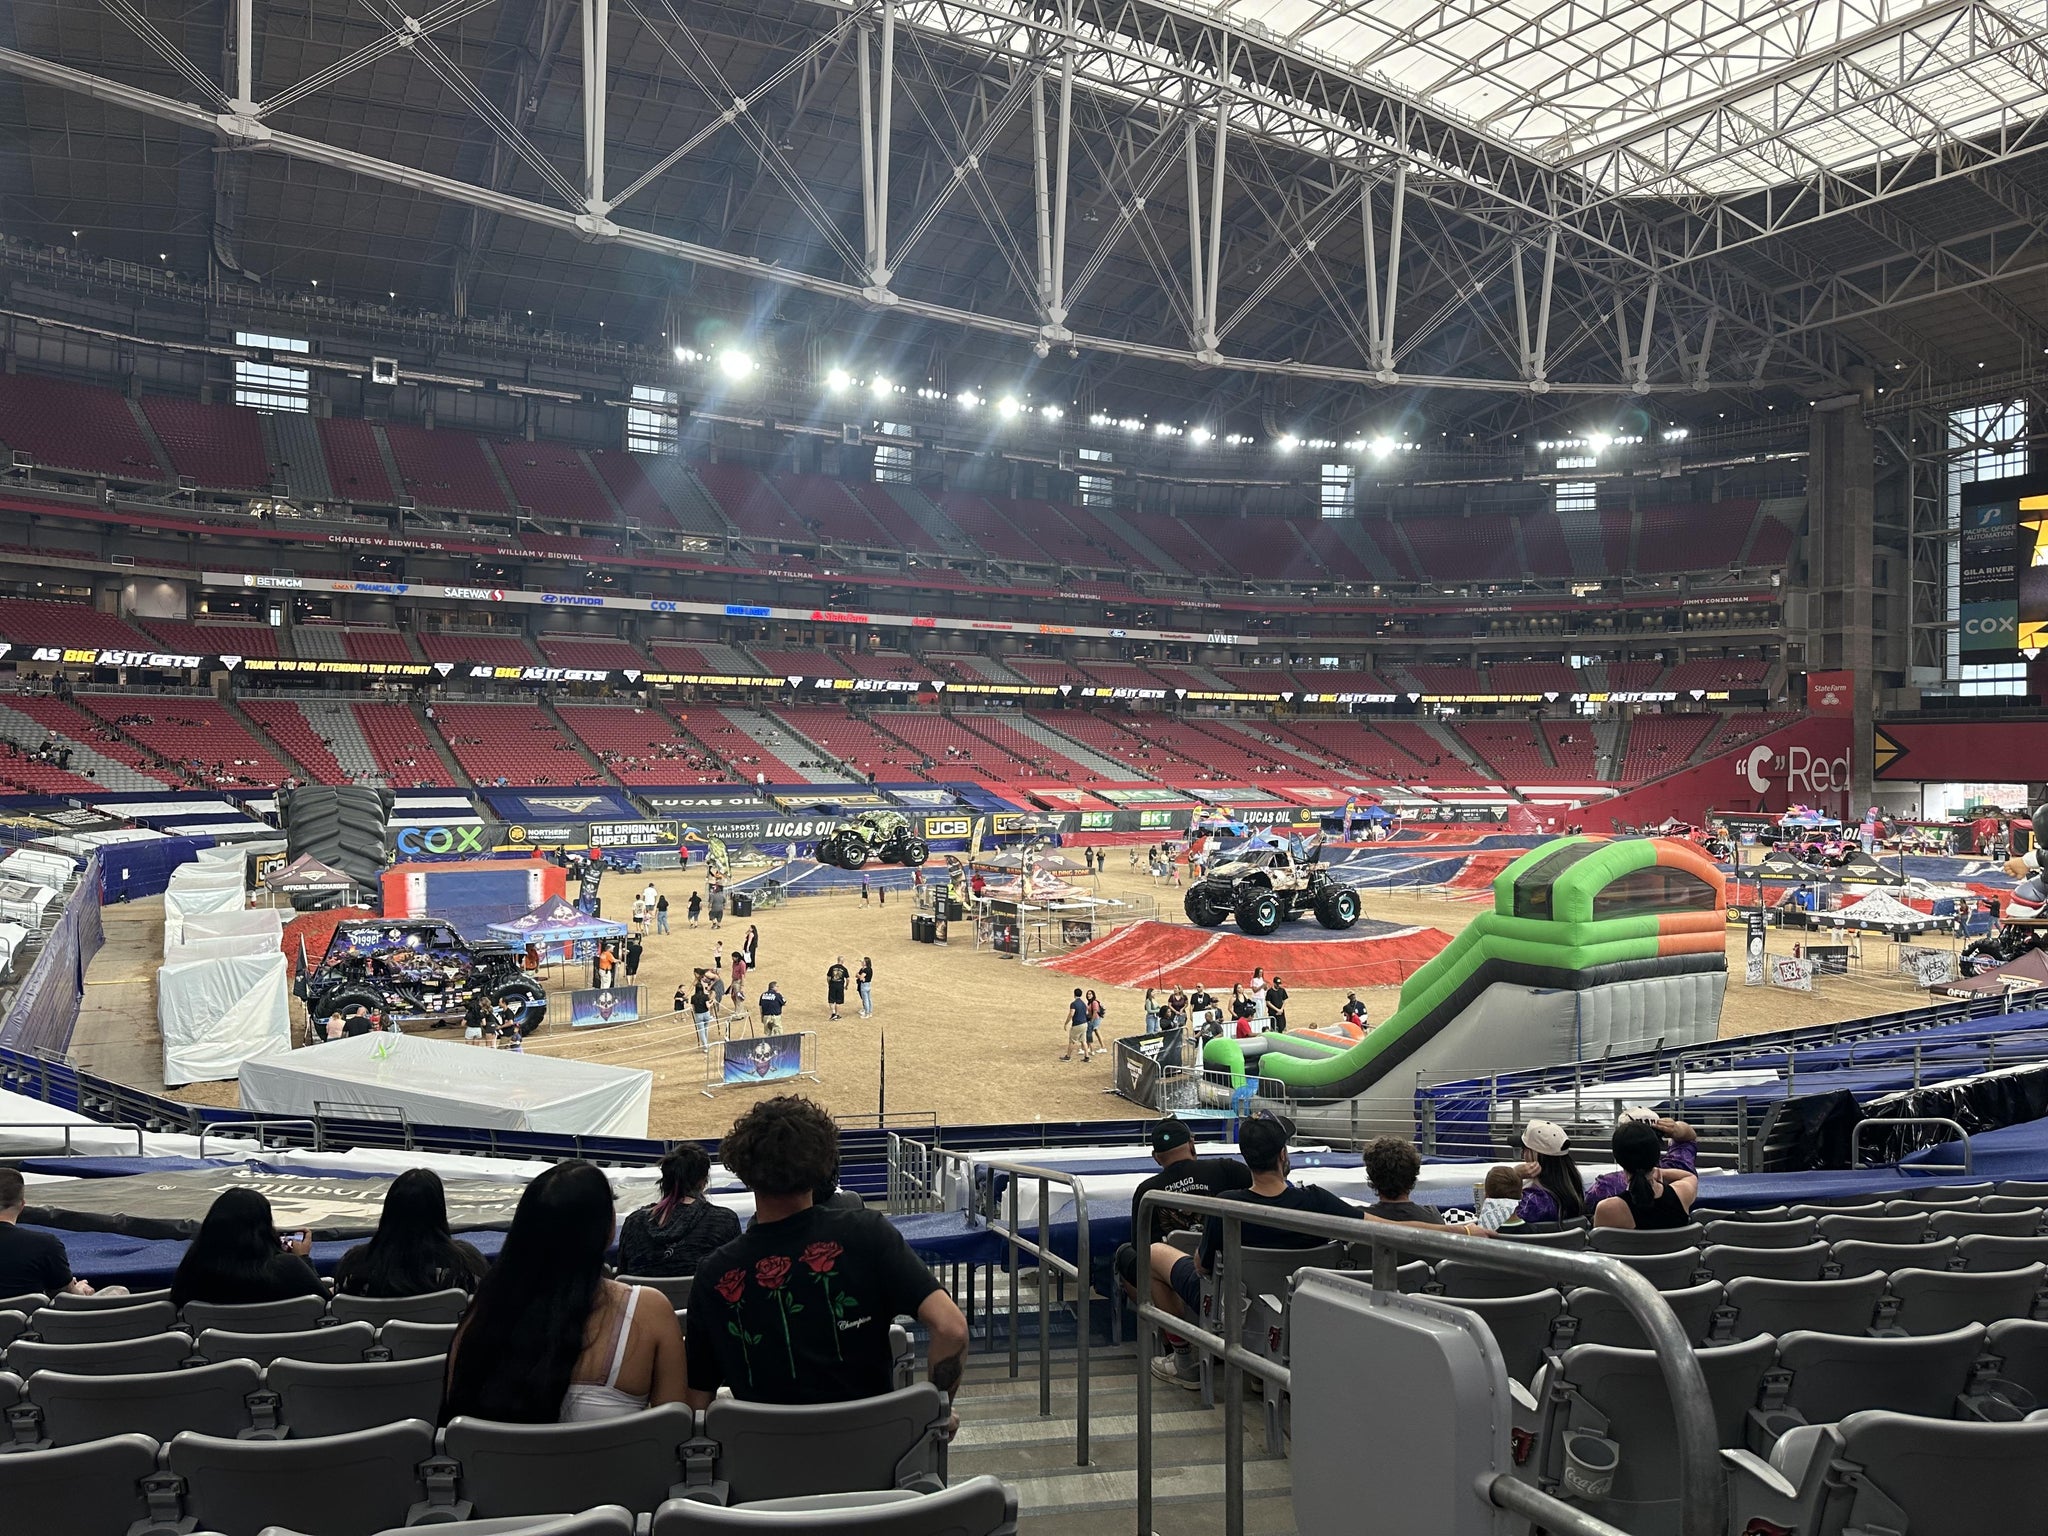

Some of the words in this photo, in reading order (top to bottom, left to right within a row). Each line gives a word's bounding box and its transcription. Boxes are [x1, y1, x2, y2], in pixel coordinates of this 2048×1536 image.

[1963, 527, 1989, 536] PACIFIC
[1991, 524, 2016, 532] OFFICE
[1966, 531, 2014, 541] AUTOMATION
[328, 535, 372, 545] CHARLES
[373, 538, 386, 546] W.
[388, 539, 428, 549] BIDWILL,
[497, 548, 536, 557] WILLIAM
[548, 552, 583, 561] BIDWILL
[783, 571, 813, 579] TILLMAN
[1963, 568, 1985, 576] GILA
[1986, 566, 2014, 574] RIVER
[257, 576, 303, 588] BETMGM
[444, 587, 491, 600] SAFEWAY
[559, 596, 604, 606] HYUNDAI
[650, 601, 676, 611] COX
[1705, 596, 1749, 604] CONZELMAN
[1965, 616, 2014, 634] COX
[1207, 634, 1239, 645] AVNET
[32, 648, 61, 661] AS
[63, 649, 97, 663] BIG
[98, 651, 125, 665] AS
[126, 652, 149, 667] IT
[244, 660, 276, 671] THANK
[278, 661, 297, 672] YOU
[297, 662, 317, 672] FOR
[317, 662, 368, 673] ATTENDING
[368, 664, 386, 674] THE
[387, 665, 402, 674] PIT
[402, 665, 432, 675] PARTY
[470, 666, 493, 678] AS
[494, 667, 522, 679] BIG
[522, 668, 545, 680] AS
[546, 668, 563, 681] IT
[815, 679, 833, 689] AS
[833, 679, 853, 690] BIG
[854, 680, 872, 691] AS
[1814, 684, 1847, 692] StateFarm
[1081, 688, 1095, 697] AS
[1096, 688, 1113, 697] BIG
[1113, 688, 1127, 698] AS
[1570, 693, 1587, 701] AS
[1588, 693, 1608, 701] BIG
[1609, 692, 1627, 702] AS
[1627, 692, 1642, 702] IT
[1788, 746, 1850, 793] Red
[1081, 813, 1113, 826] BKT
[1140, 812, 1171, 826] BKT
[1243, 812, 1273, 824] LUCAS
[1275, 811, 1291, 823] OIL
[591, 825, 613, 835] THE
[615, 823, 661, 834] ORIGINAL
[765, 822, 812, 838] LUCAS
[929, 821, 968, 835] JCB
[397, 826, 482, 854] COX
[591, 835, 628, 845] SUPER
[631, 834, 657, 844] GLUE
[1780, 963, 1796, 973] TECH
[1784, 970, 1801, 980] DECK
[1165, 1177, 1194, 1192] CHICAGO
[837, 1315, 872, 1331] Champion
